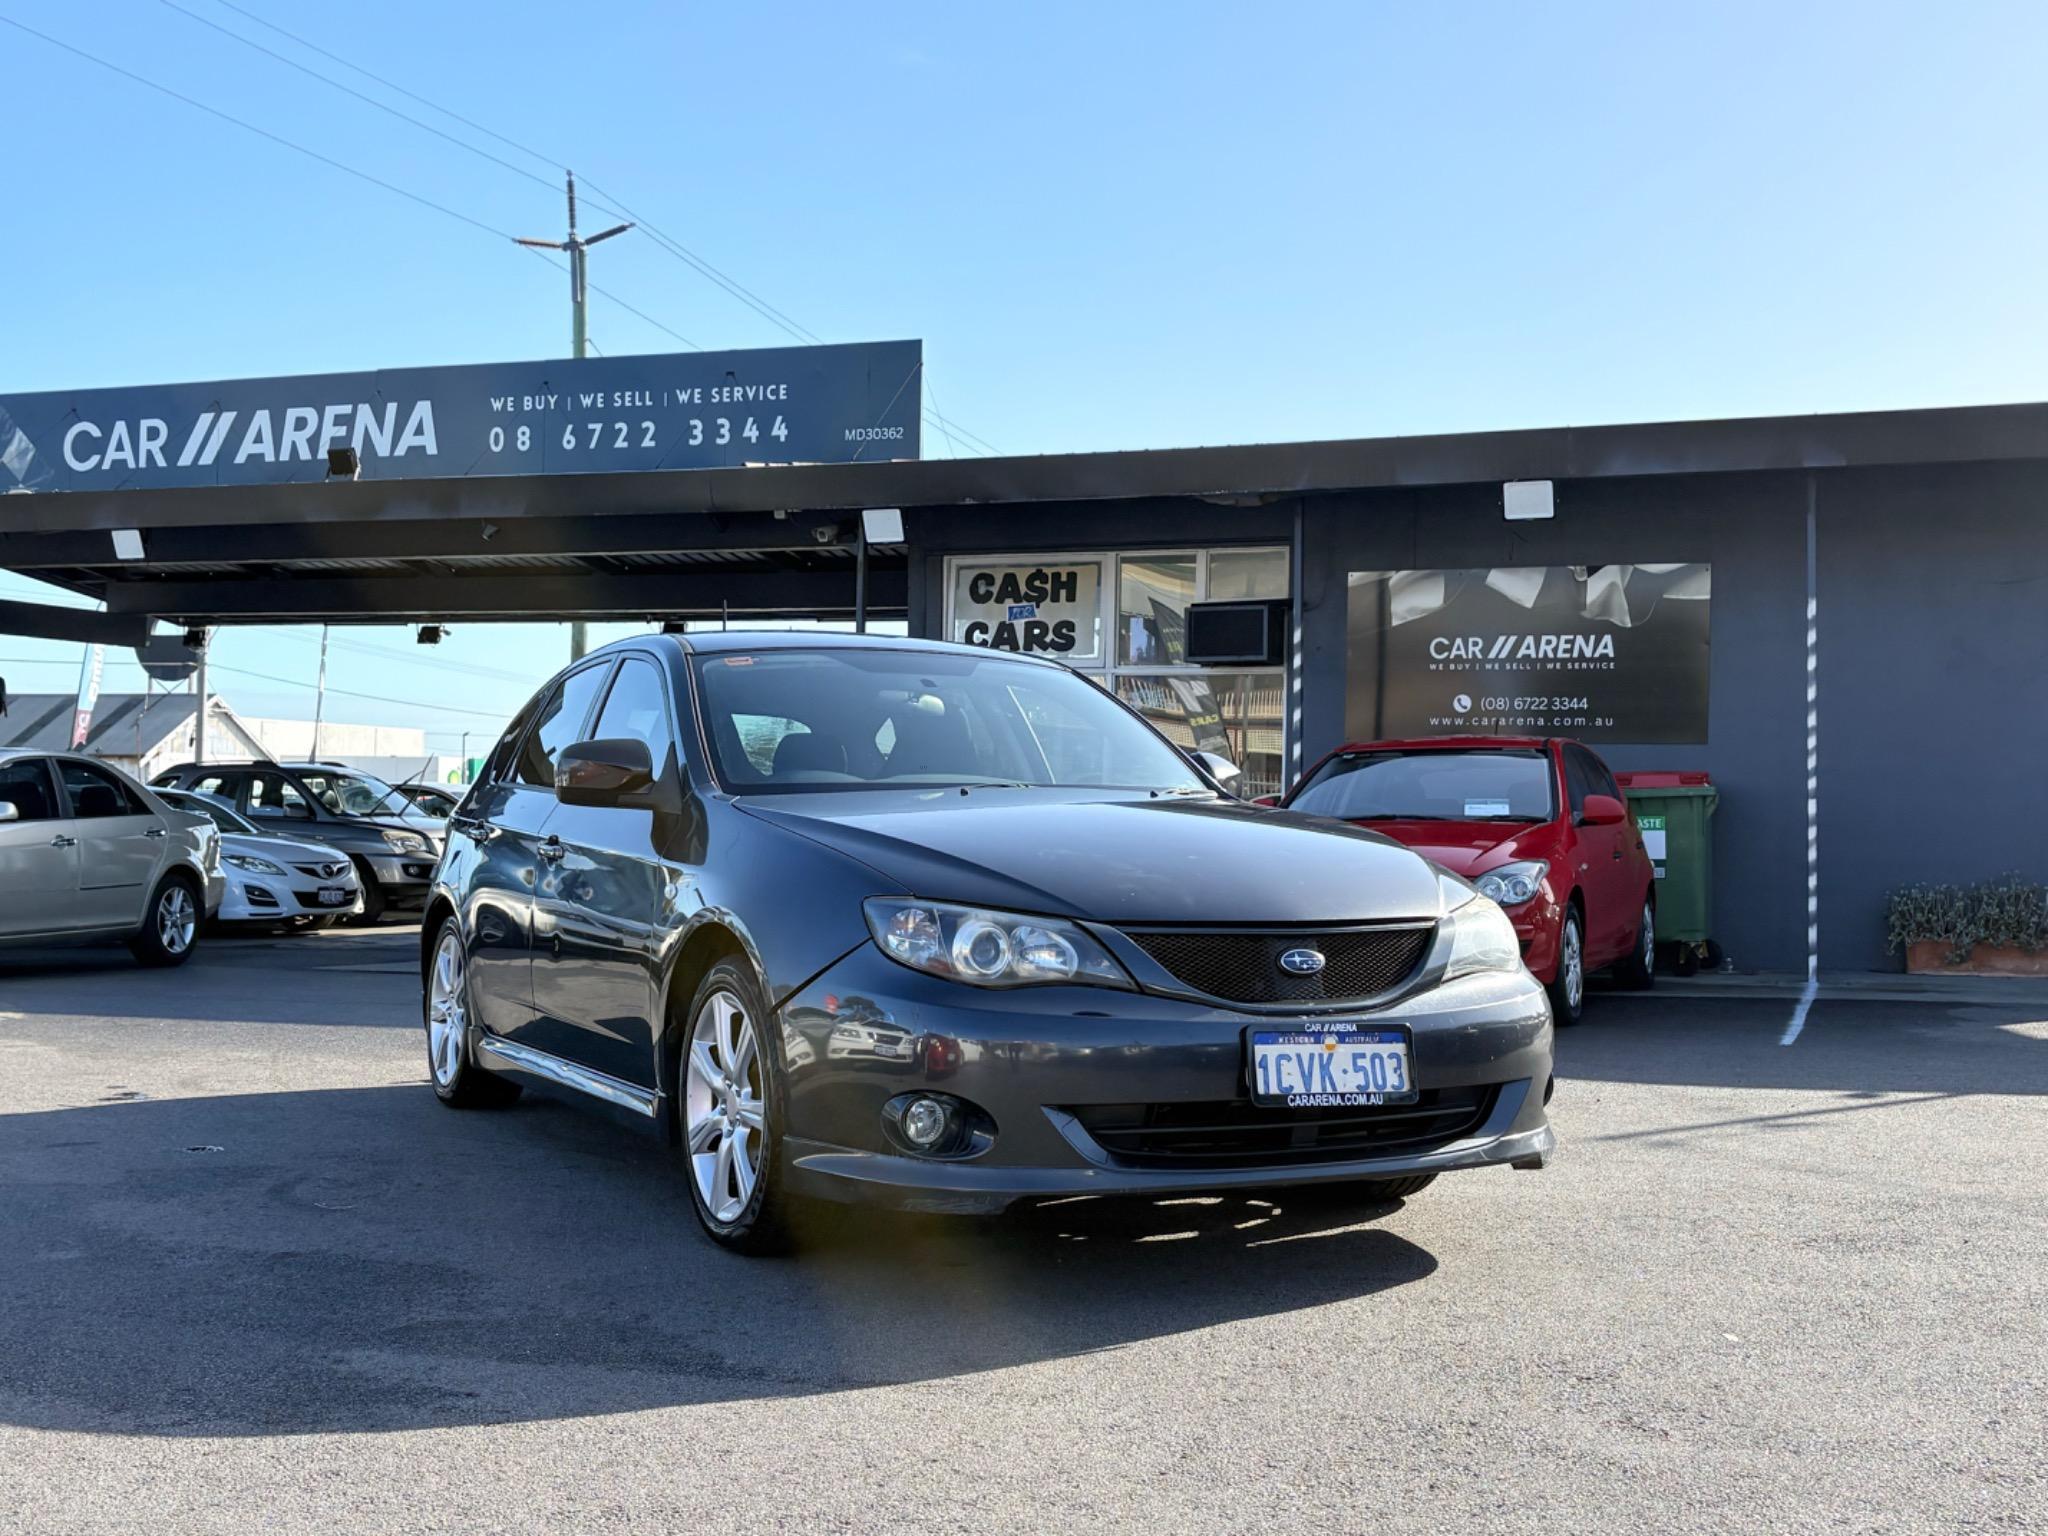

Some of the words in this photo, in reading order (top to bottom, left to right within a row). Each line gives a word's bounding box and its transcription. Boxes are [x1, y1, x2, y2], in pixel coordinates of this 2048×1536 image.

[490, 397, 515, 412] WE
[523, 394, 559, 411] BUY
[579, 393, 606, 409] WE
[613, 391, 654, 407] SELL
[676, 388, 703, 404] WE
[711, 384, 789, 403] SERVICE
[63, 417, 169, 472] CAR
[233, 399, 438, 464] ARENA
[489, 424, 531, 453] 08
[562, 420, 657, 451] 6722
[688, 415, 789, 446] 3344
[844, 427, 904, 441] MD30362
[964, 619, 1077, 652] CARS
[1429, 636, 1483, 660] CAR
[1516, 633, 1615, 659] ARENA
[1546, 662, 1561, 670] WE
[1567, 662, 1615, 670] SERVICE
[1480, 697, 1510, 711] (08)
[1514, 697, 1548, 710] 6722
[1551, 697, 1588, 710] 3344
[1429, 716, 1613, 726] www.cararena.com.au
[1637, 818, 1662, 829] ASTE
[1287, 1094, 1383, 1107] CARARENA.COM.AU
